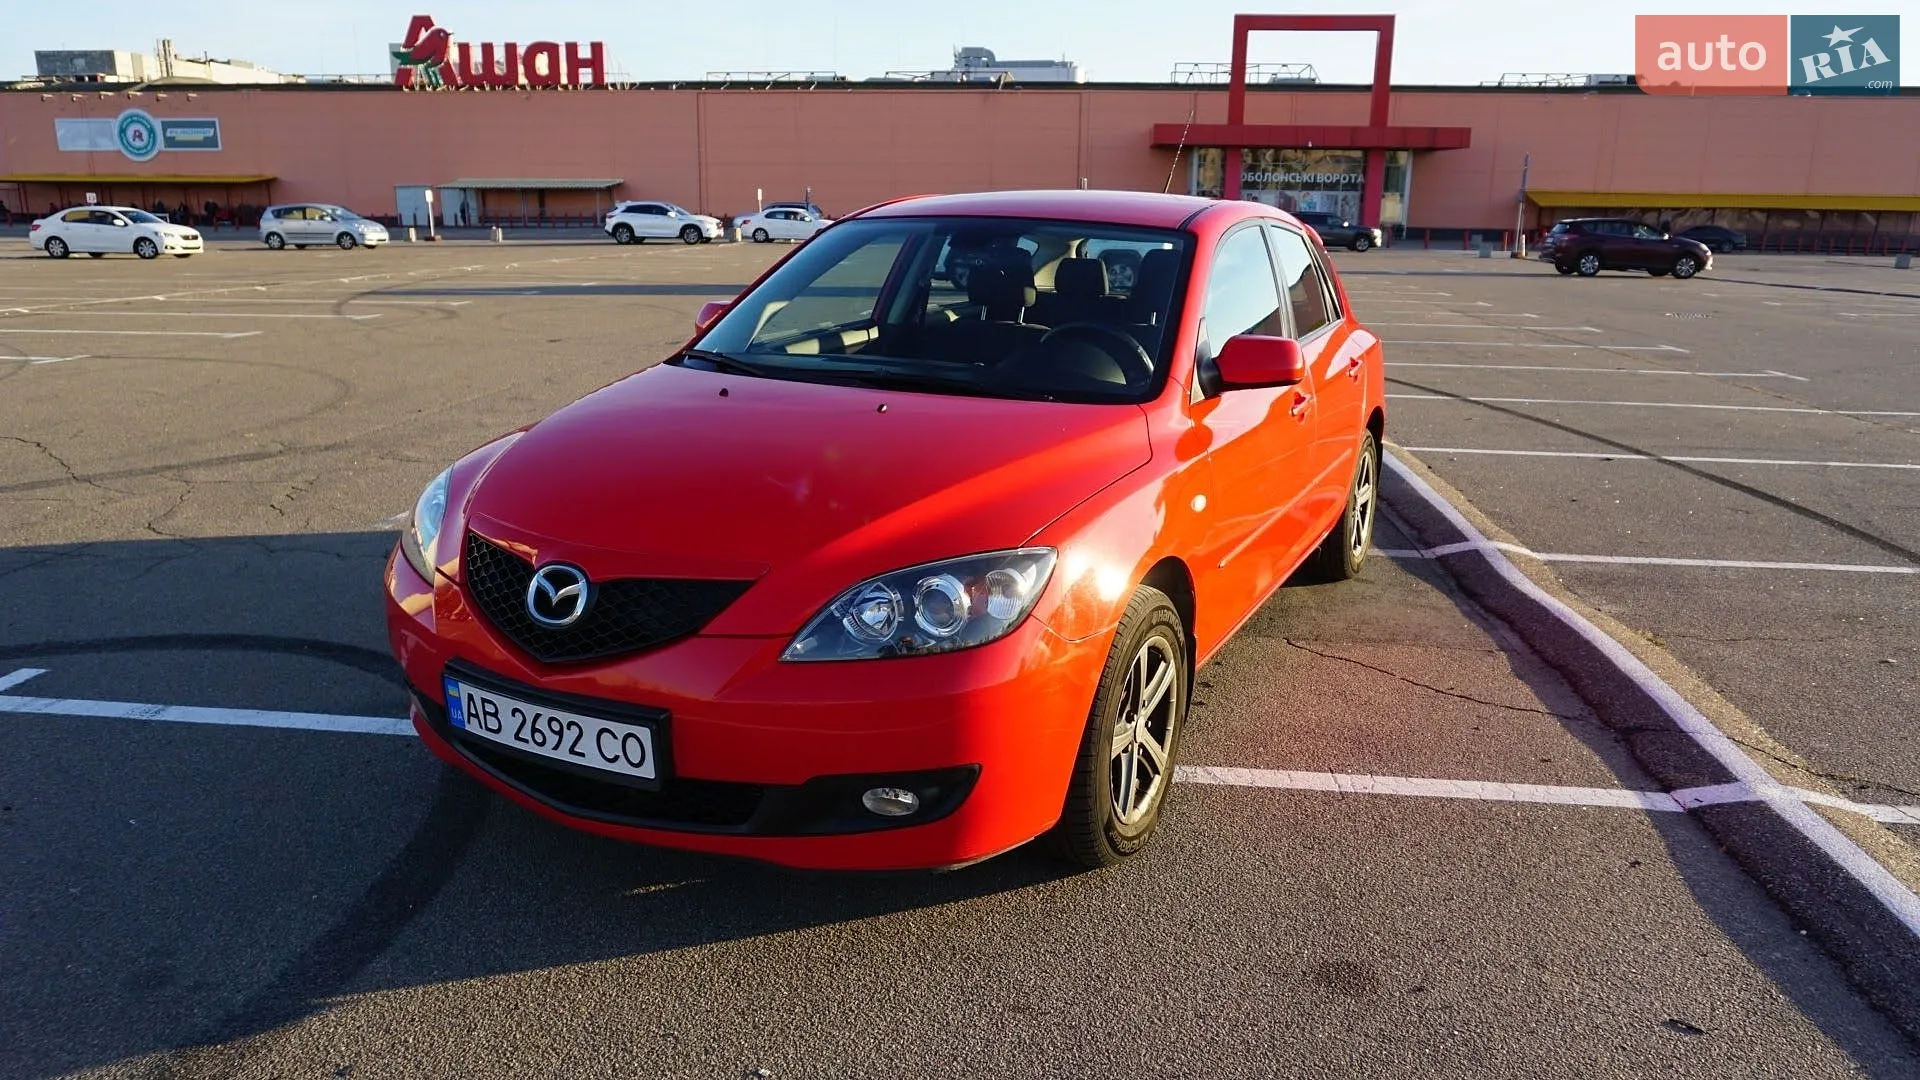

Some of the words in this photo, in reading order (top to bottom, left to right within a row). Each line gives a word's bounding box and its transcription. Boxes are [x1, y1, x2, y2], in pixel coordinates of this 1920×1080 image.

[394, 15, 606, 87] Ашан
[1241, 172, 1315, 183] ОБОЛОНСЬКІ
[1316, 173, 1365, 184] ВОРОТА
[451, 708, 464, 721] UA
[466, 692, 502, 735] AB
[511, 707, 586, 758] 2692
[596, 727, 646, 769] CO
